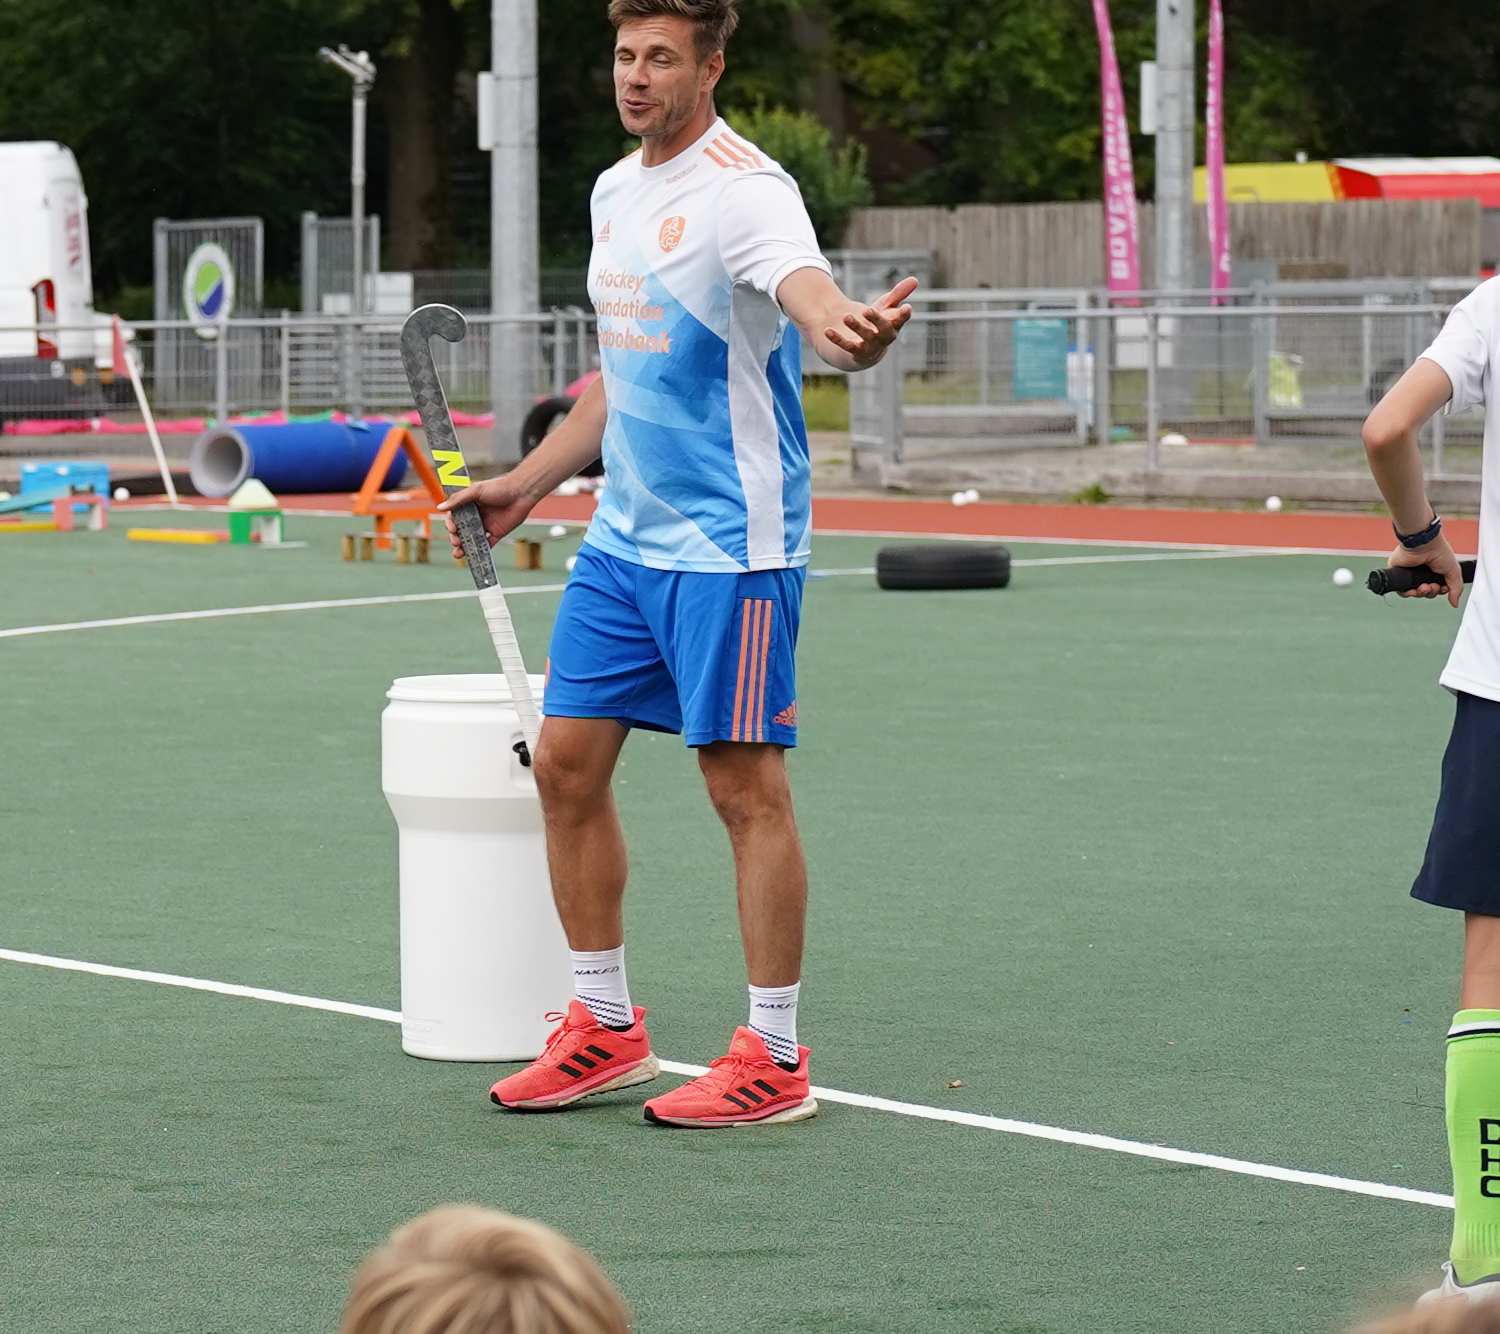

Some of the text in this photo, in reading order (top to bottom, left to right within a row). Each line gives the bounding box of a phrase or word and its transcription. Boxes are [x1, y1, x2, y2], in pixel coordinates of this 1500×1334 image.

[595, 267, 646, 295] Hockey
[593, 297, 665, 322] oundation
[574, 966, 619, 976] NAKED
